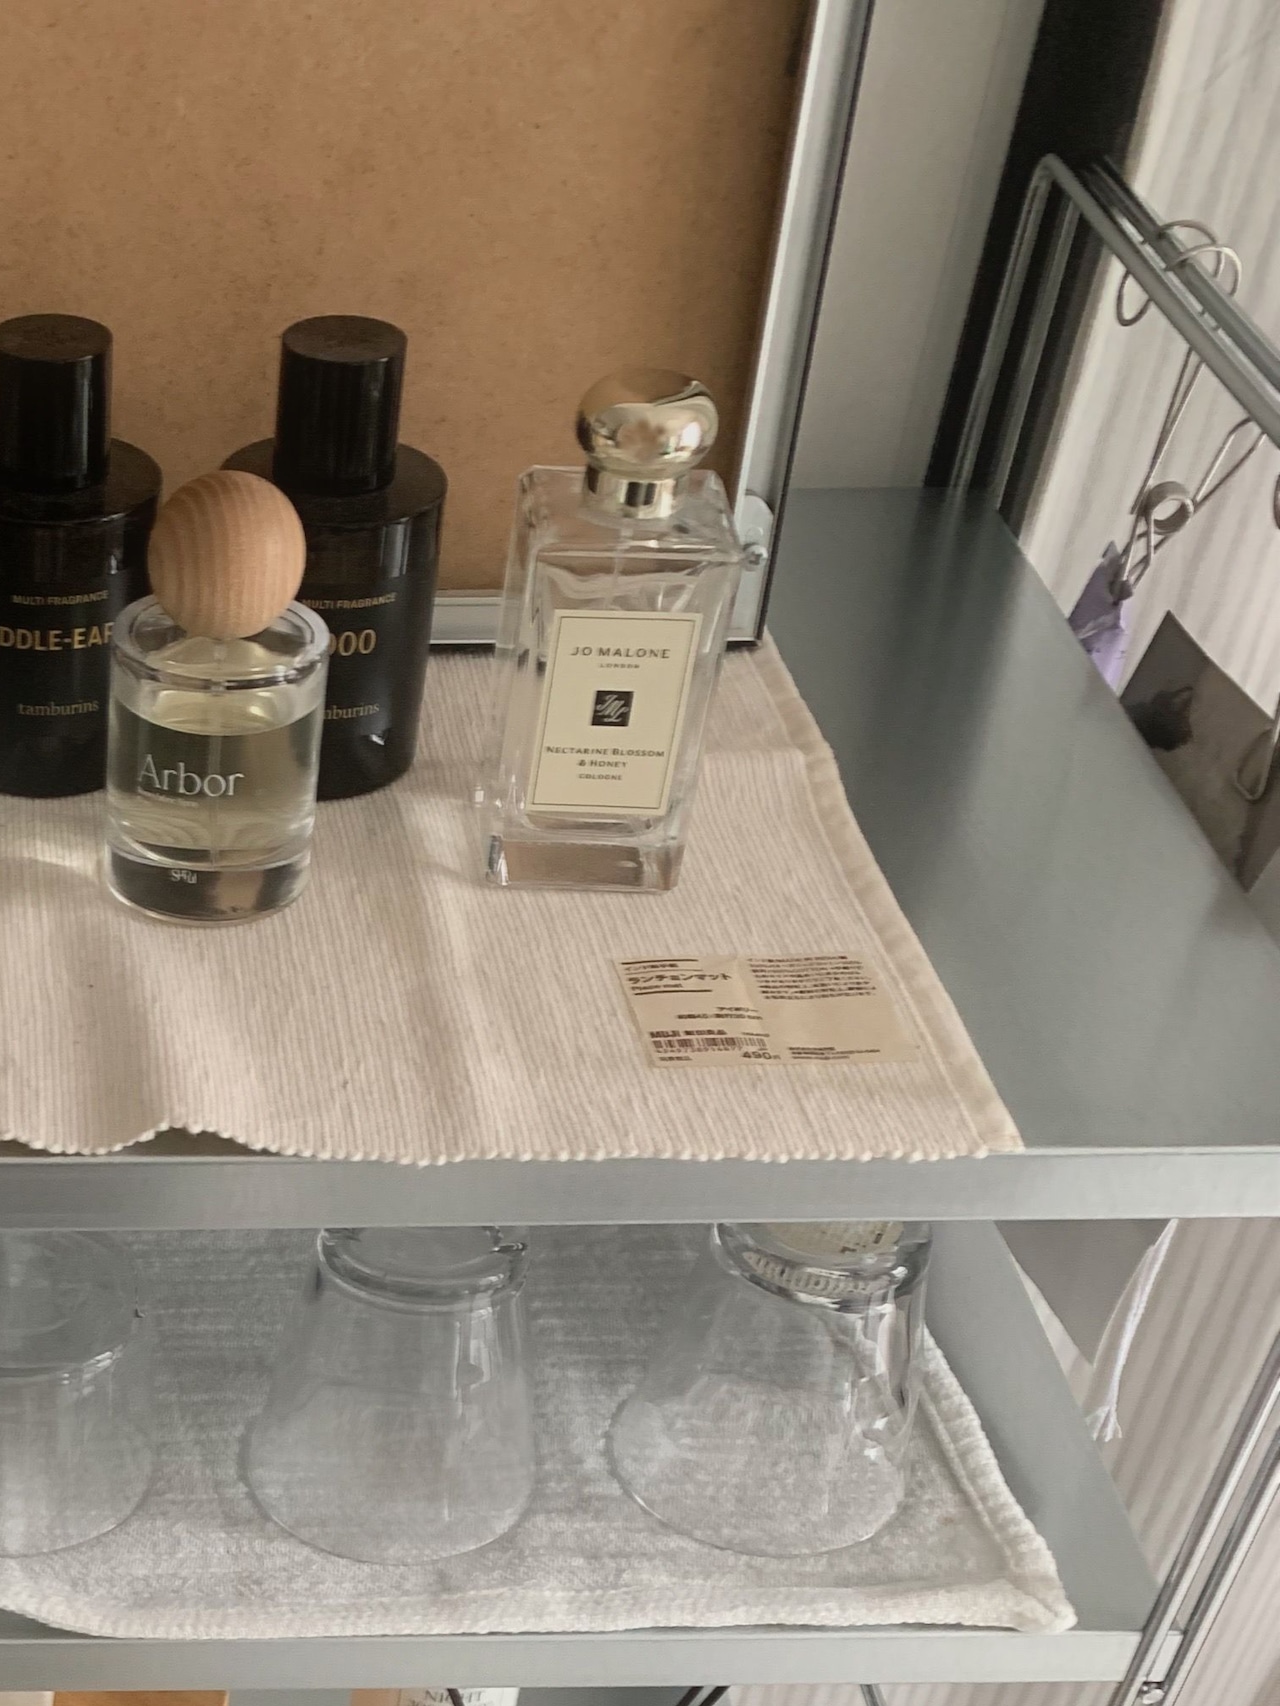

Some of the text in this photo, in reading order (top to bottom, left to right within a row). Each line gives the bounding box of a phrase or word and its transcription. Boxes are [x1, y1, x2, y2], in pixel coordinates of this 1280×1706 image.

[336, 592, 397, 609] FRAGRANCE
[570, 646, 671, 659] JO MALONE
[19, 700, 100, 716] tamburins
[589, 760, 628, 768] HONEY
[137, 754, 245, 797] Arbor
